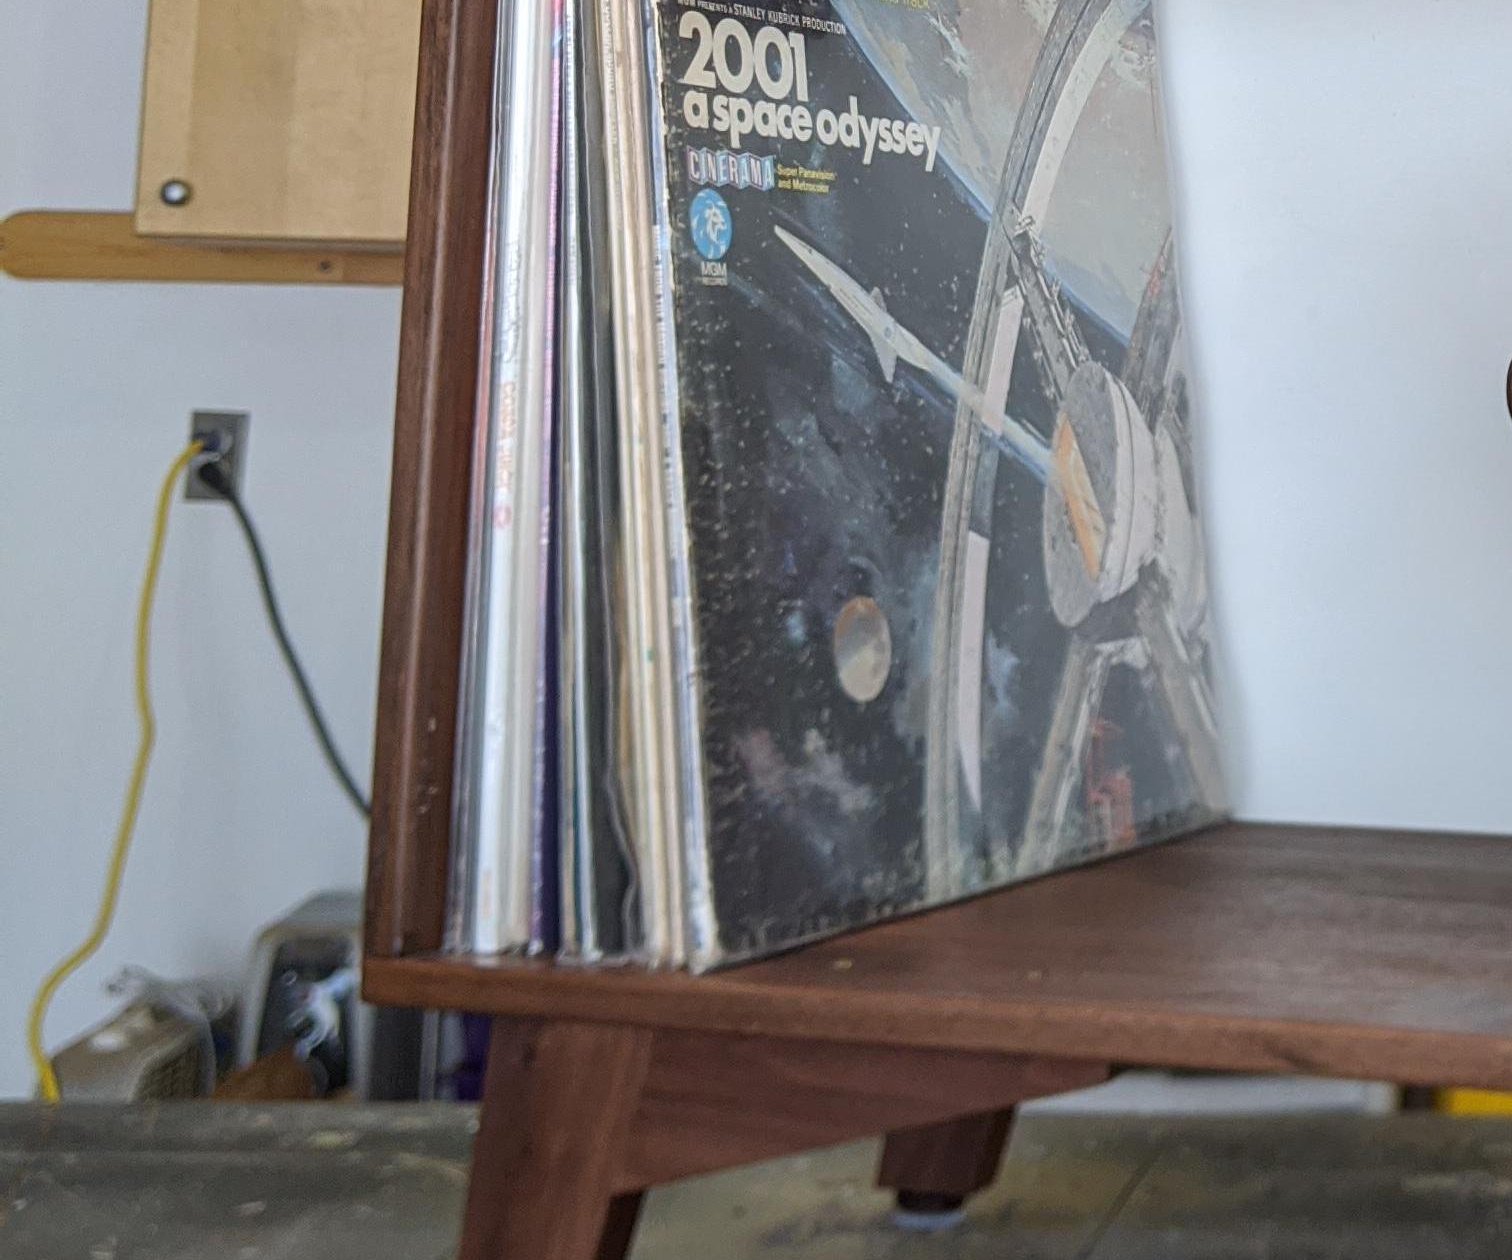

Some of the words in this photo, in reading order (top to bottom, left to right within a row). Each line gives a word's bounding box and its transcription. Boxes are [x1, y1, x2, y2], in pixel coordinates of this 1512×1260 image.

[733, 3, 767, 21] STANLEY
[767, 10, 801, 27] KUBRICK
[802, 15, 847, 36] PRODUCTION
[678, 10, 809, 102] 2001
[683, 90, 709, 129] a
[712, 94, 812, 149] space
[816, 95, 941, 172] odyssey
[688, 149, 774, 188] CINERAMA
[701, 261, 728, 277] MGM
